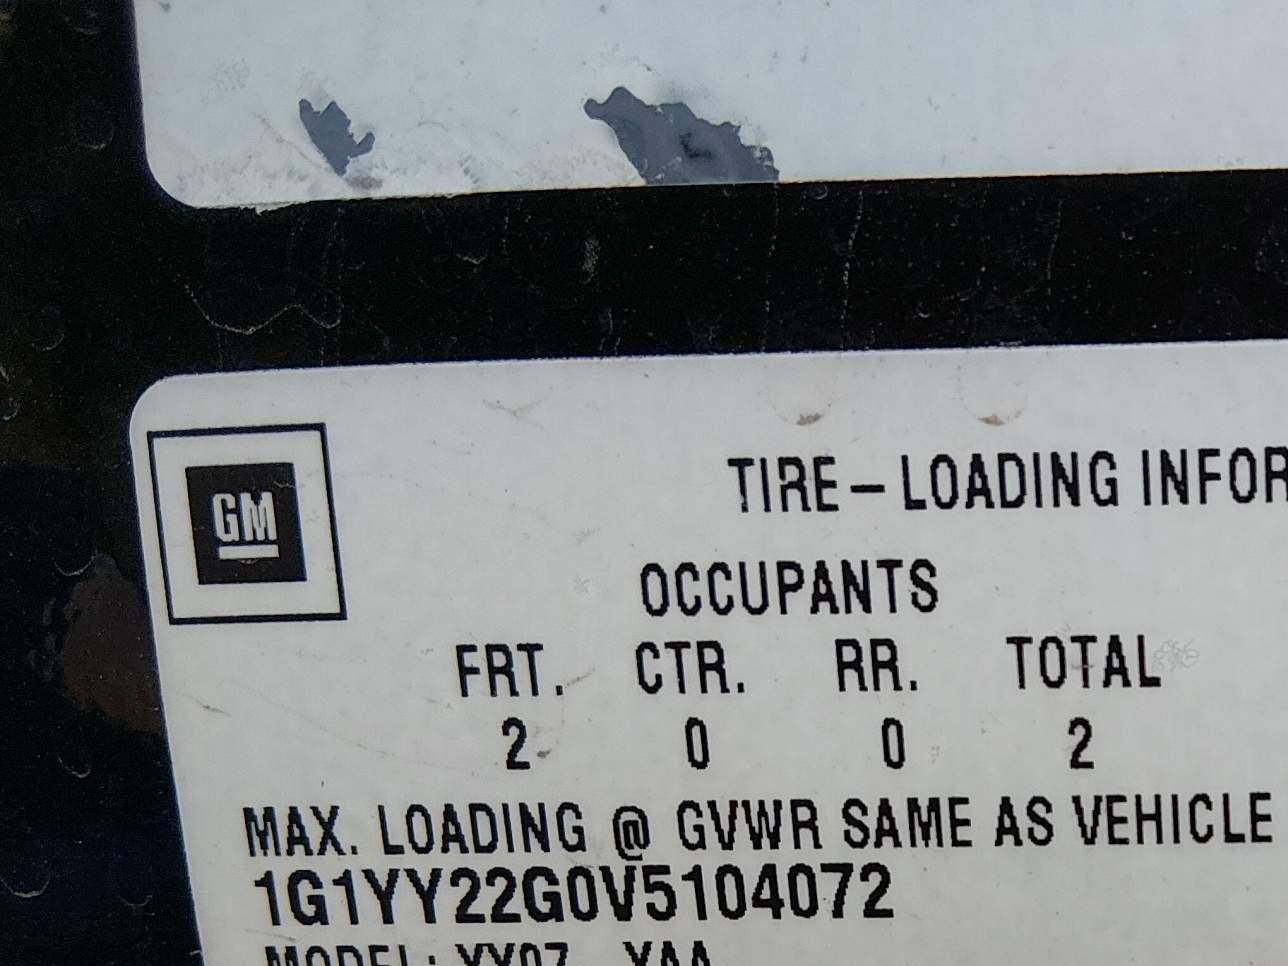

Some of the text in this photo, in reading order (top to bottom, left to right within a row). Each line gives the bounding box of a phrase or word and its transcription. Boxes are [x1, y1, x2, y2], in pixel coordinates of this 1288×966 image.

[727, 455, 840, 514] TIRE
[900, 450, 1119, 511] LOADING
[213, 491, 279, 543] GM
[639, 558, 939, 618] OCCUPANTS
[455, 634, 1162, 698] FRT. CTR. RR. TOTAL
[501, 716, 1095, 771] 2 0 0 2
[242, 804, 359, 858] MAX.
[377, 801, 587, 856] LOADING
[611, 805, 651, 862] @
[676, 798, 823, 852] GVWR
[841, 796, 973, 850] SAME
[994, 795, 1055, 848] AS
[1071, 791, 1273, 846] VEHICLE
[253, 861, 895, 927] 1G1YY22G0V5104072
